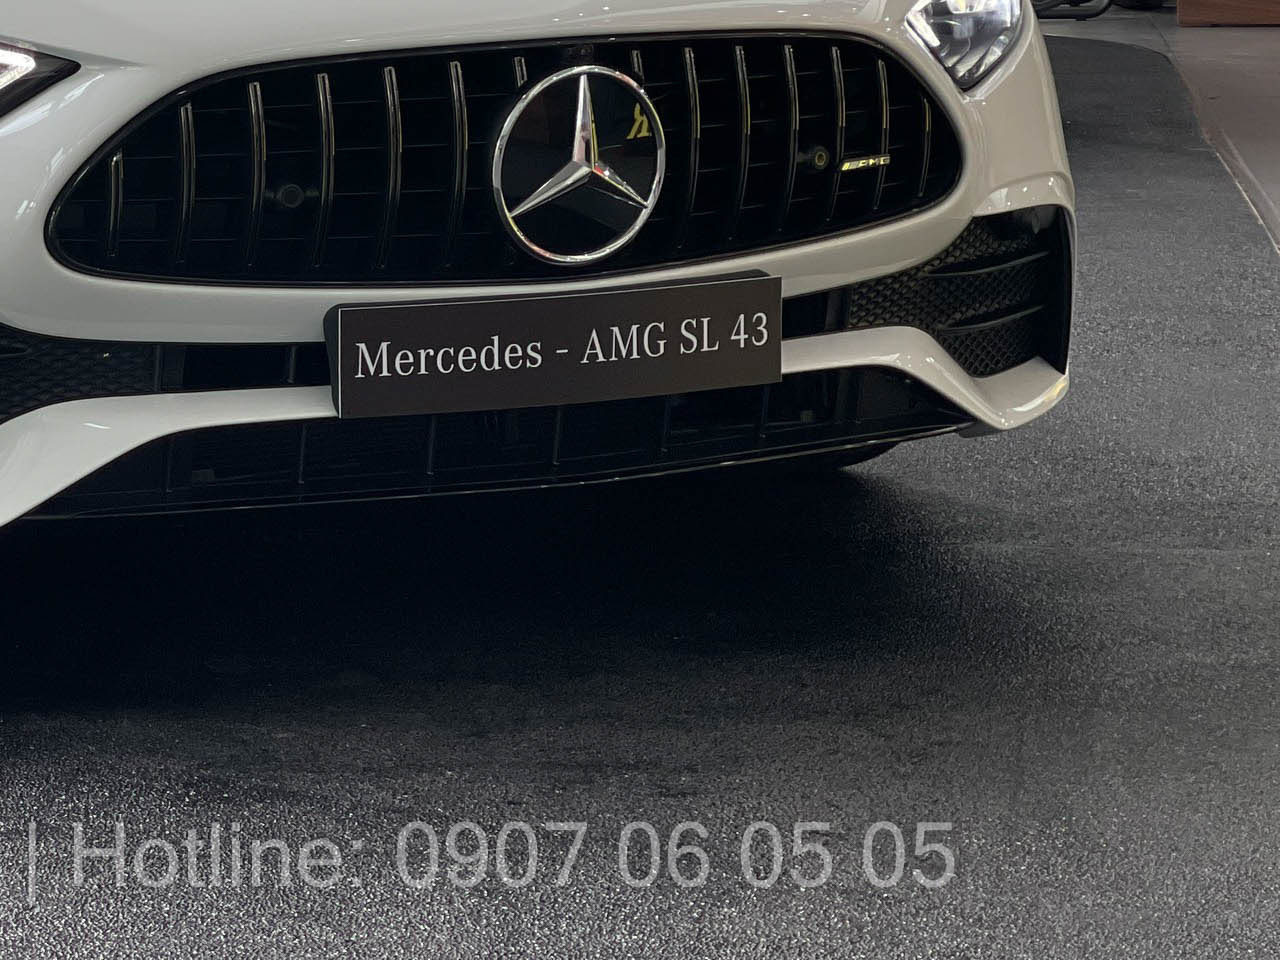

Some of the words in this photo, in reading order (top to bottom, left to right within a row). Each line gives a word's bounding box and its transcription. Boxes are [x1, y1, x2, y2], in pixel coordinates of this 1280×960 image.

[354, 335, 543, 378] Mercedes
[580, 321, 666, 364] AMG
[679, 316, 719, 355] SL
[730, 311, 769, 348] 43
